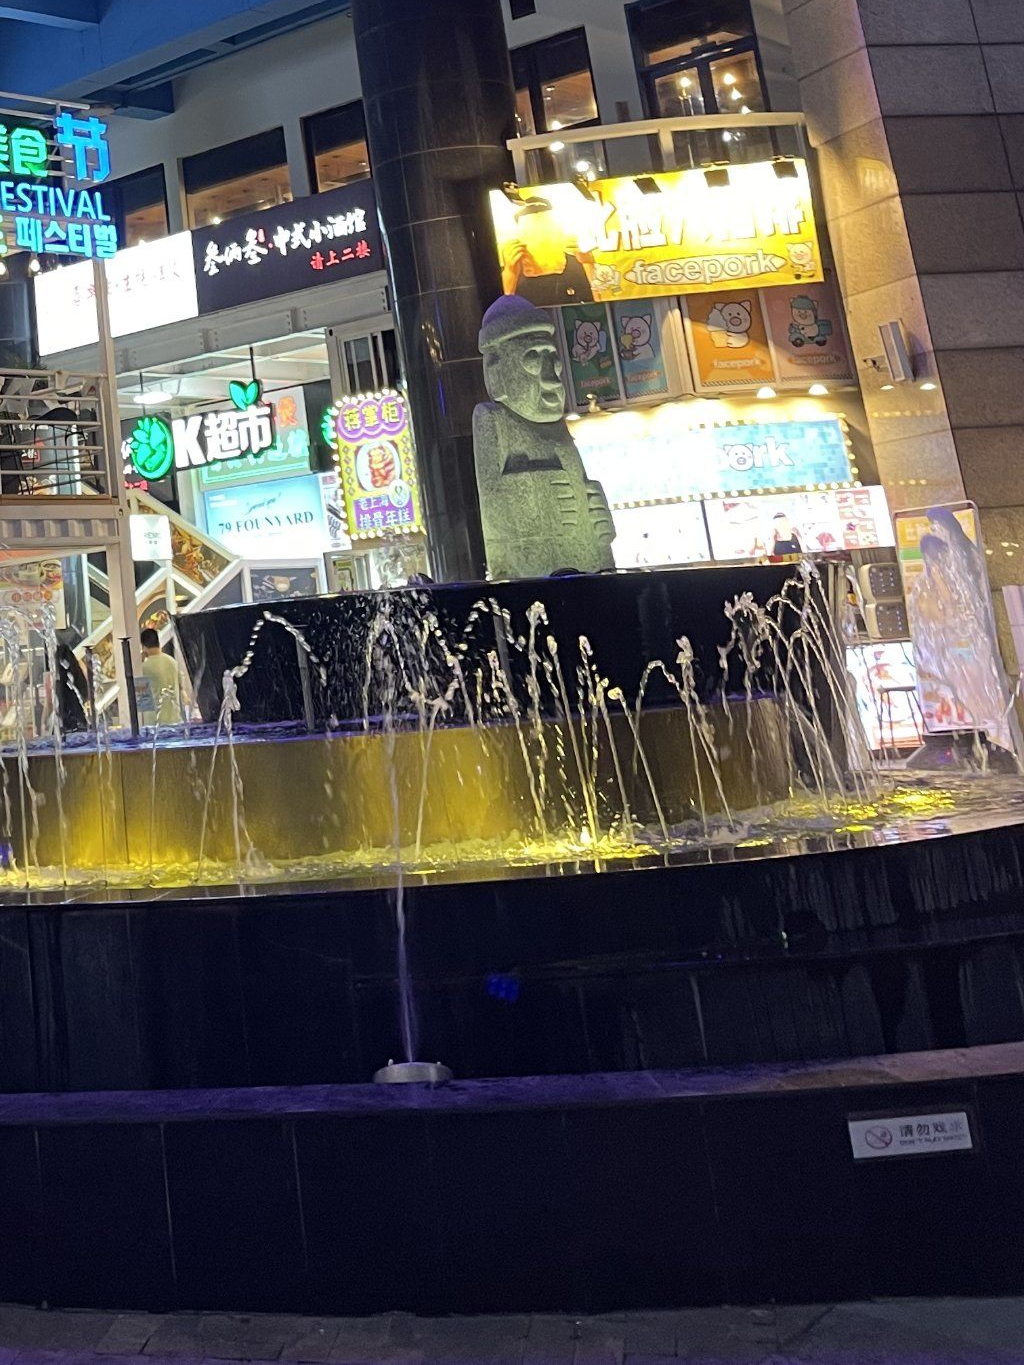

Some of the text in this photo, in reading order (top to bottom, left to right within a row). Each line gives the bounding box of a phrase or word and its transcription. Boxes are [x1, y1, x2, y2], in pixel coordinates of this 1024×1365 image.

[15, 216, 118, 260] 페스티벌
[310, 239, 372, 270] 请上二楼
[632, 250, 778, 285] facepork
[711, 358, 762, 370] facepork
[171, 405, 274, 469] K超市
